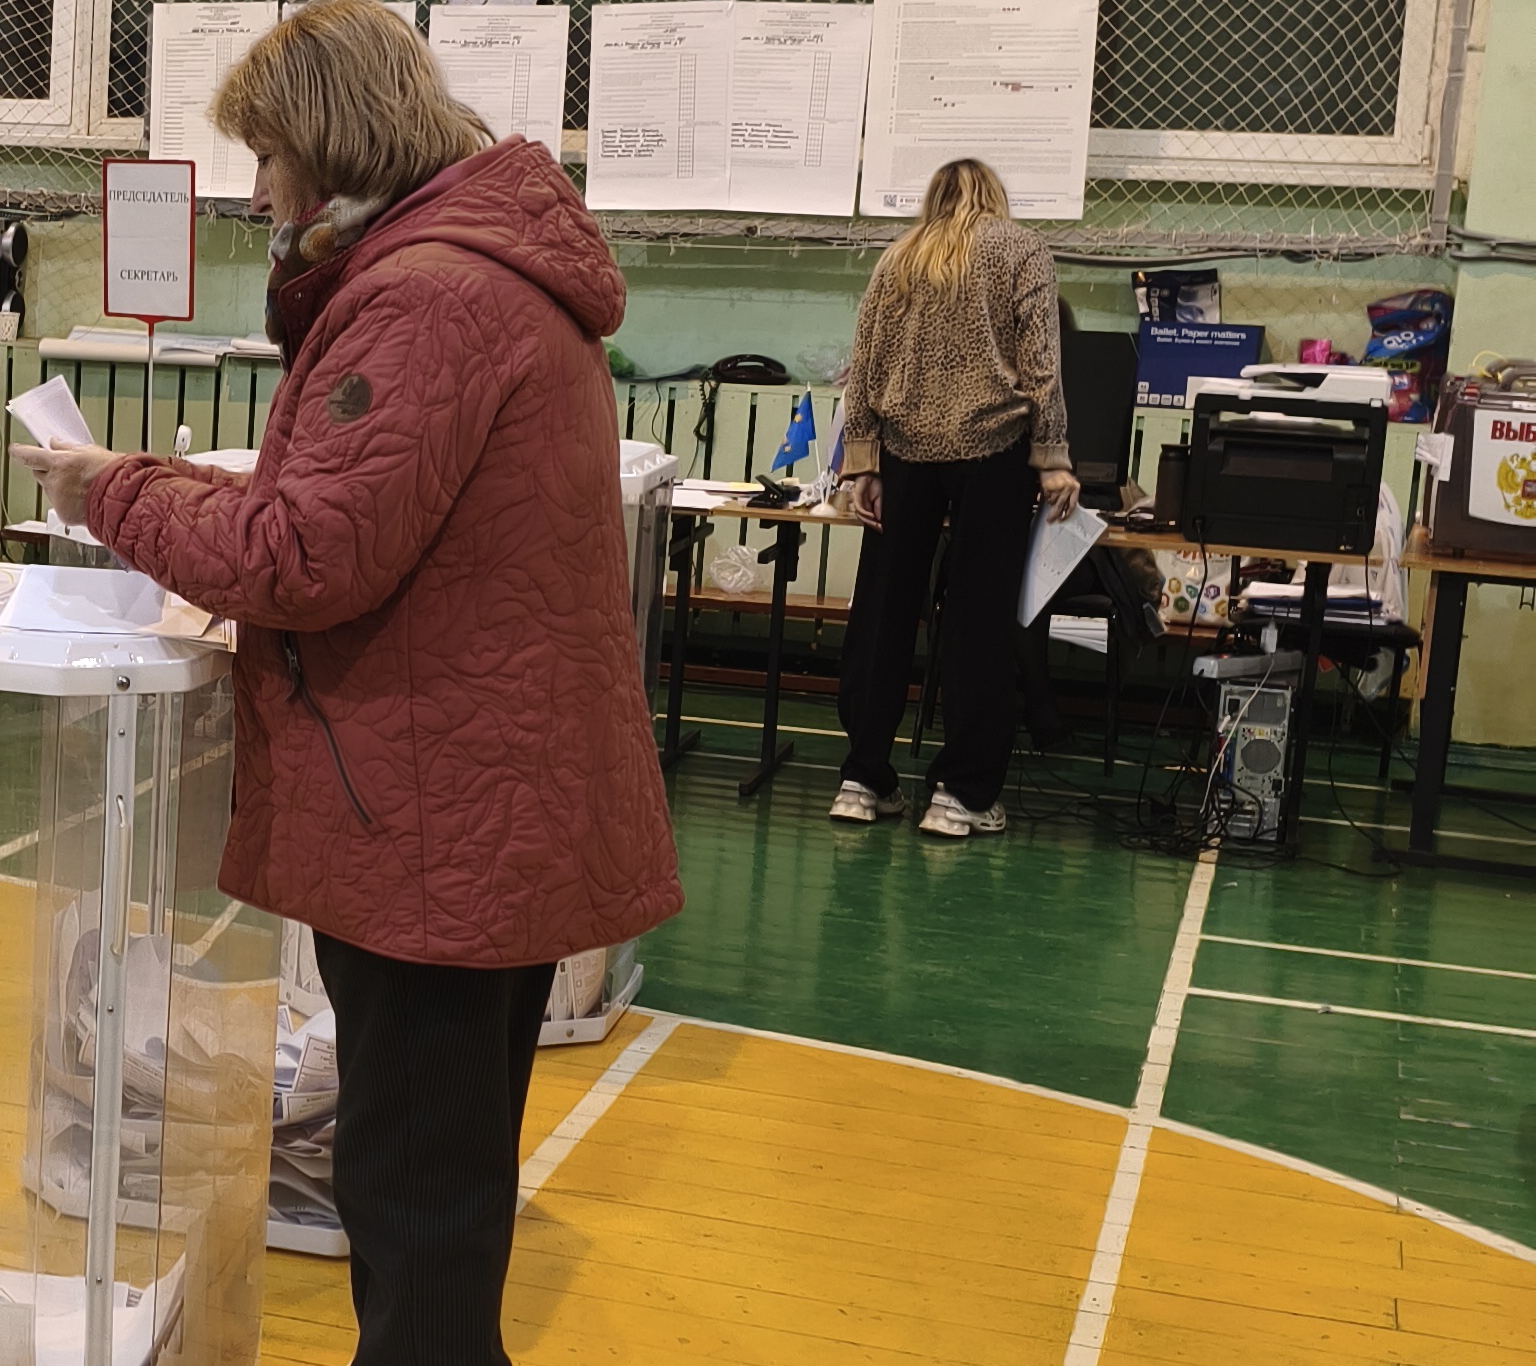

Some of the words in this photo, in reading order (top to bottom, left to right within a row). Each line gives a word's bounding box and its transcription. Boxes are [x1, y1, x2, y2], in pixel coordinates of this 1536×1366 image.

[109, 189, 189, 204] ПРЕДСЕДАТЕЛЬ
[120, 268, 178, 283] СЕКРЕТАРЬ
[1181, 328, 1209, 339] Paper
[1491, 419, 1536, 443] ВЫБ
